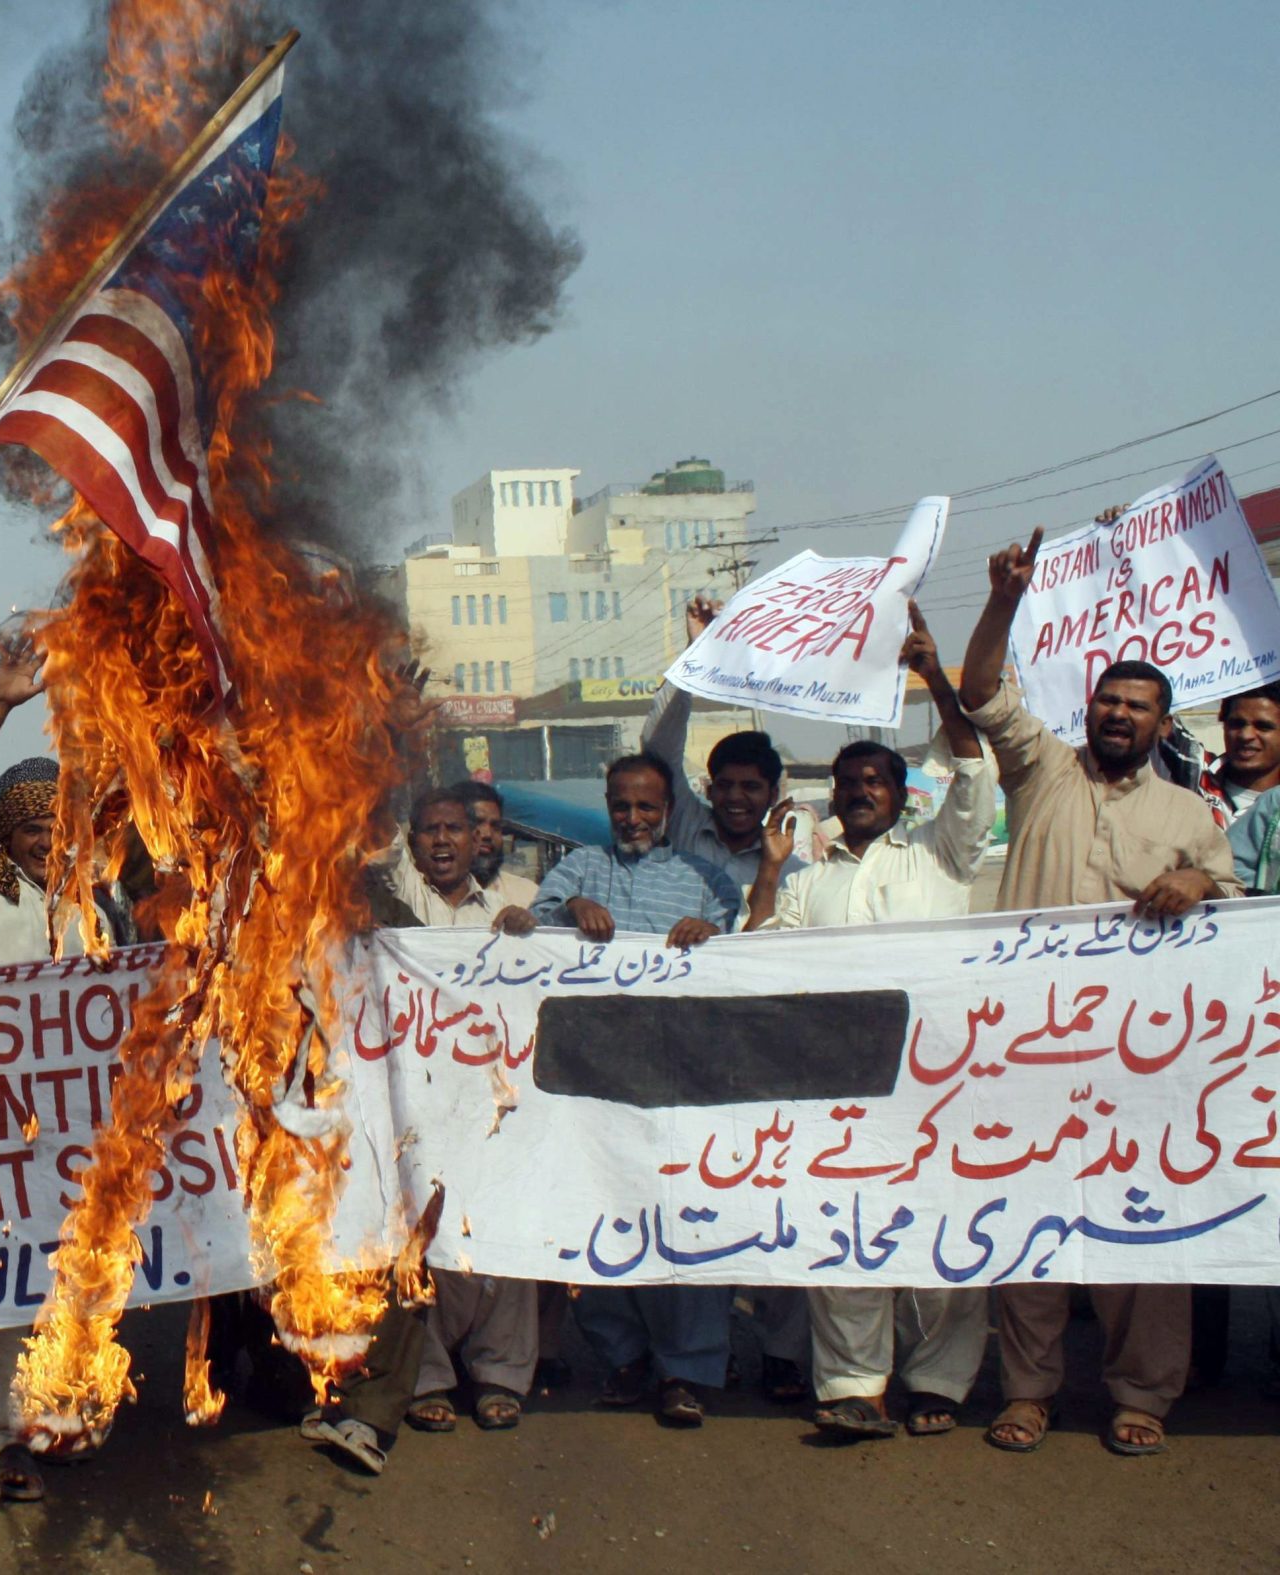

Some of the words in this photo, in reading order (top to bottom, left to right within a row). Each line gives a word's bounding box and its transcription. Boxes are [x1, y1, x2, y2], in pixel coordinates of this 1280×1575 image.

[1024, 537, 1099, 595] KISTANI
[1111, 470, 1228, 558] GOVERNMENT
[1031, 552, 1229, 665] AMERICAN
[1106, 557, 1133, 591] IS
[618, 679, 657, 697] CNG
[764, 677, 804, 696] MAHAZ
[1084, 611, 1231, 704] DOGS.
[1170, 674, 1214, 692] MAHAZ
[1219, 651, 1277, 680] MULTAN.
[558, 944, 611, 985] حملے
[614, 943, 692, 987] ڈرون
[1027, 924, 1069, 958] بند
[1074, 912, 1126, 956] حملے
[1128, 904, 1218, 955] ڈرون
[480, 958, 554, 986] بند
[355, 972, 484, 1061] مسلمانوں
[909, 996, 1006, 1085] میں
[1005, 982, 1115, 1064] حملے
[1118, 966, 1280, 1075] ڈرون
[807, 1081, 965, 1185] کرتے
[1160, 1063, 1247, 1185] کی
[809, 1192, 915, 1271] محاذ
[933, 1187, 1267, 1284] شہری
